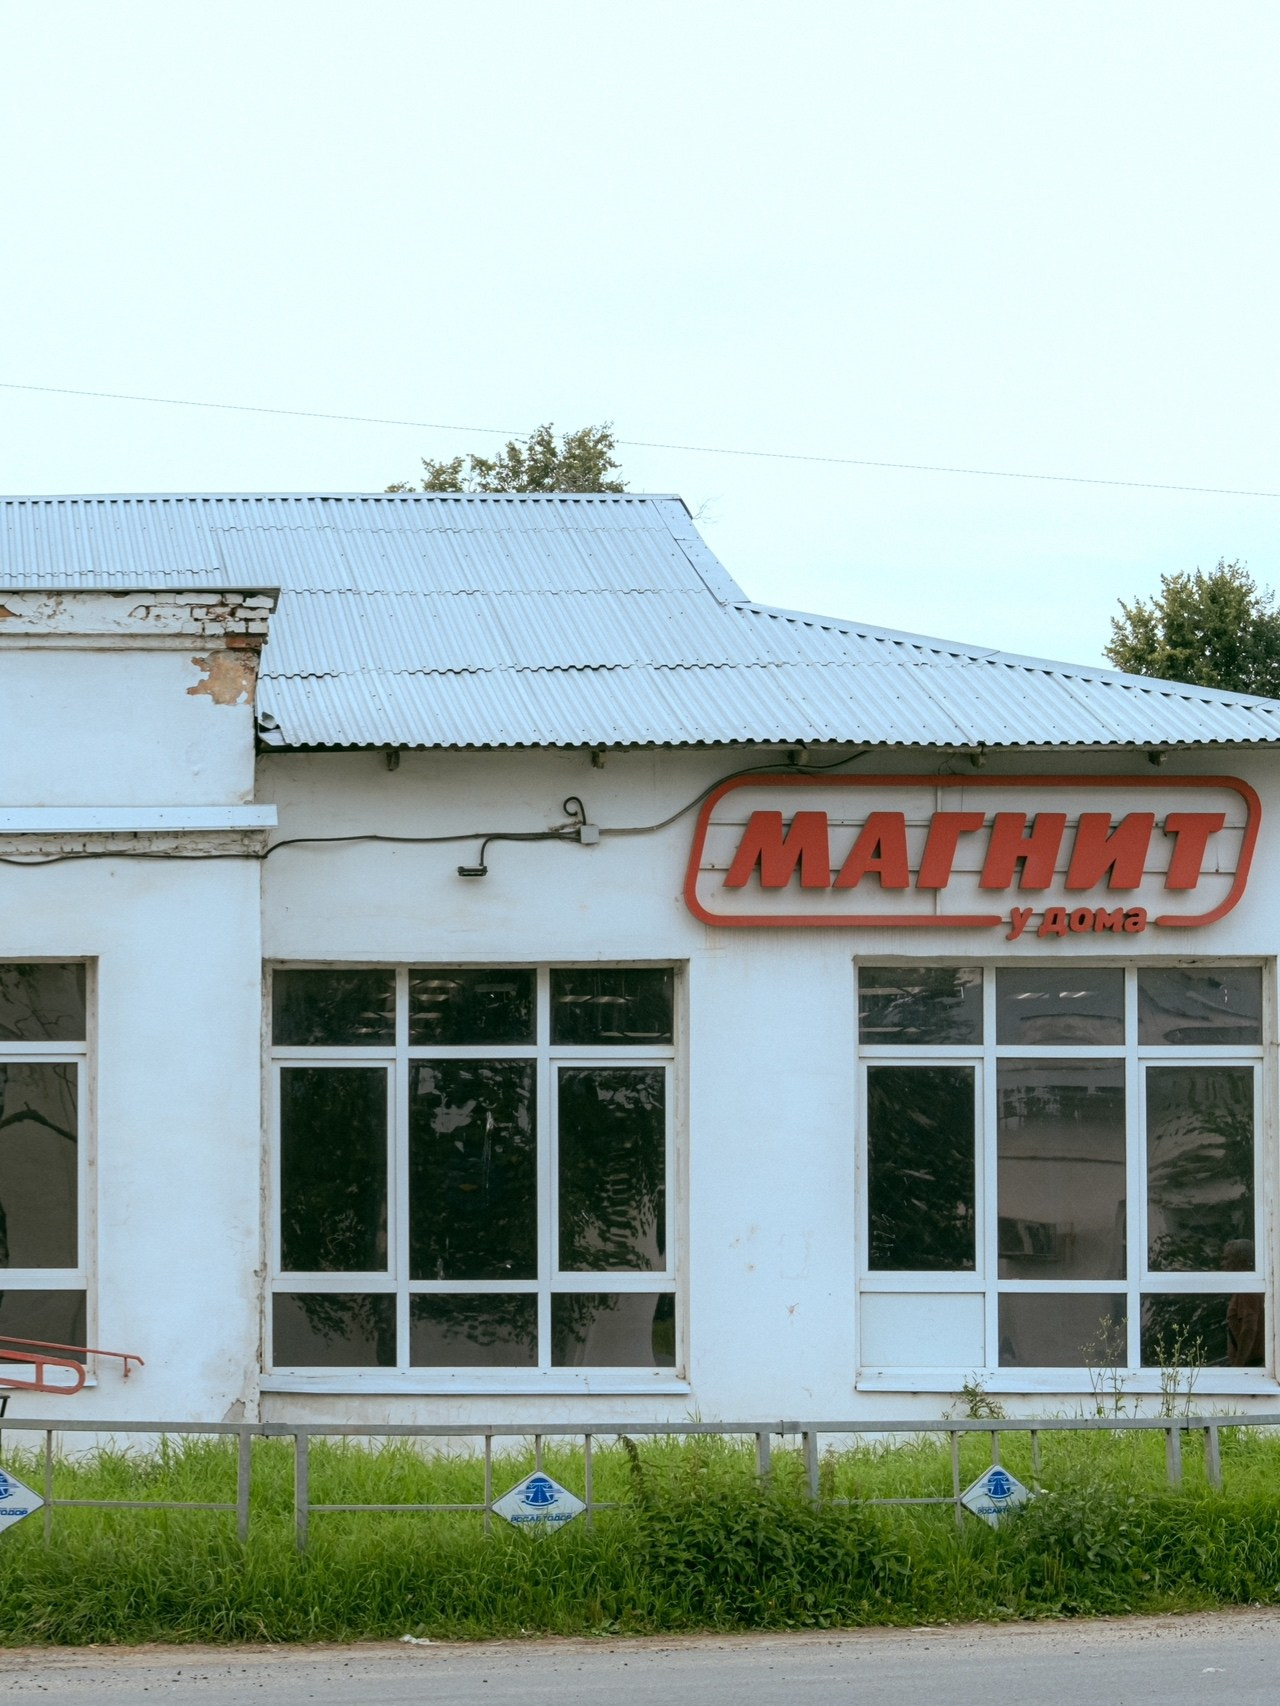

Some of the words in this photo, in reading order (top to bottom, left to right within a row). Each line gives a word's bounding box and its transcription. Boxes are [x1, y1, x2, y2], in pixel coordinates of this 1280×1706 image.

[722, 810, 1226, 890] МАГНИТ
[1005, 906, 1034, 941] у
[1037, 906, 1148, 938] дома
